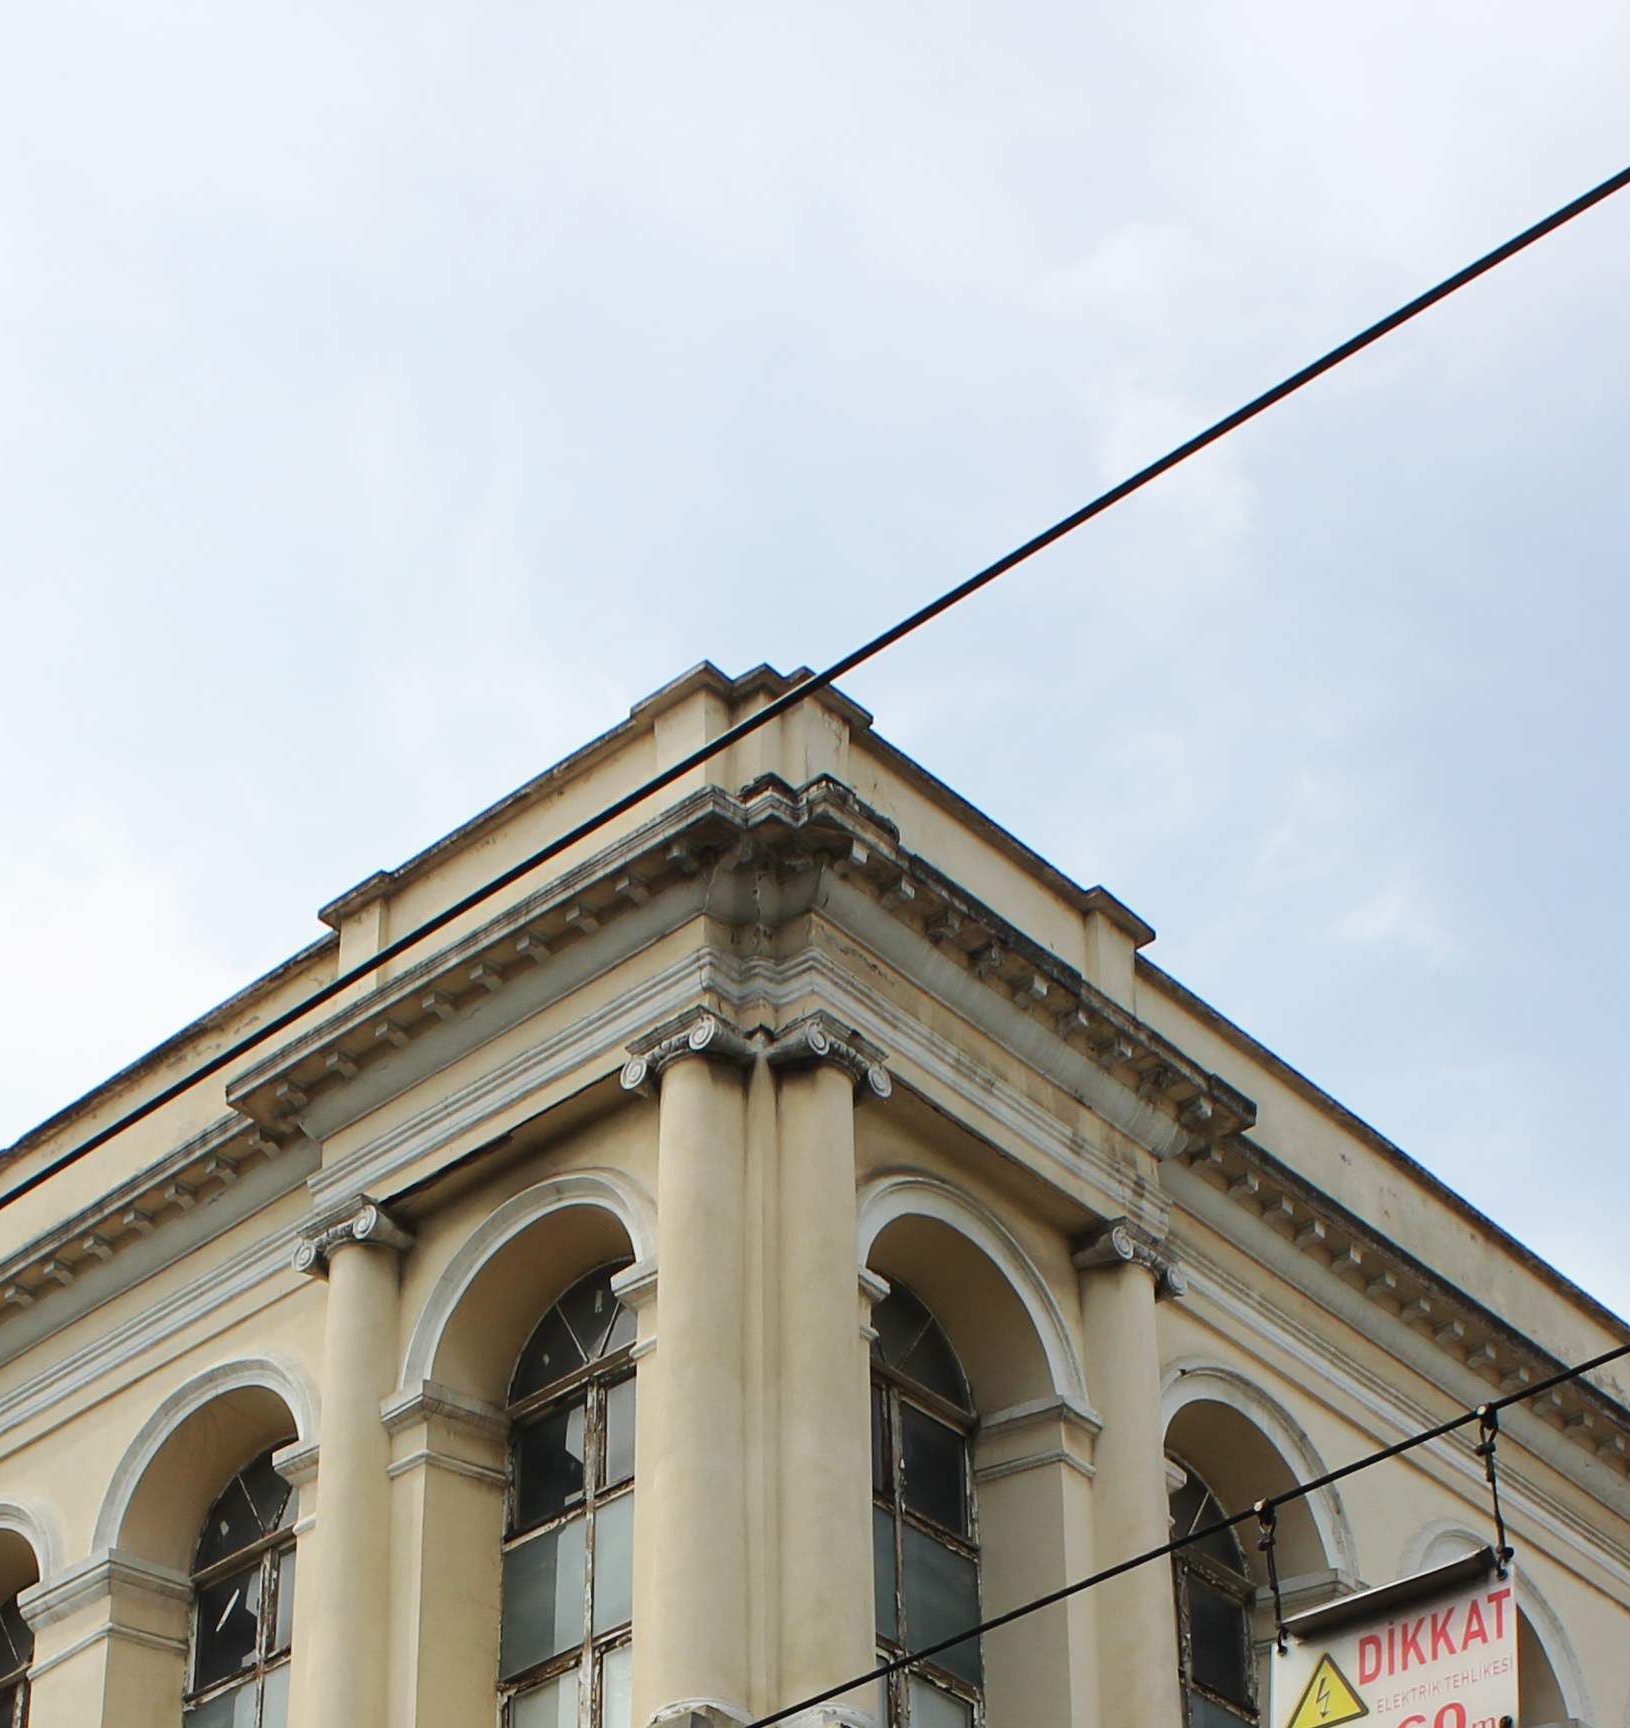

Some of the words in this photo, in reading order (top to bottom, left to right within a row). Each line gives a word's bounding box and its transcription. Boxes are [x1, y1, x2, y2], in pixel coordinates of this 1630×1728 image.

[1358, 1588, 1511, 1685] DİKKAT
[1377, 1678, 1441, 1714] ELEKTRİK
[1444, 1652, 1514, 1689] TEHLİKESİ
